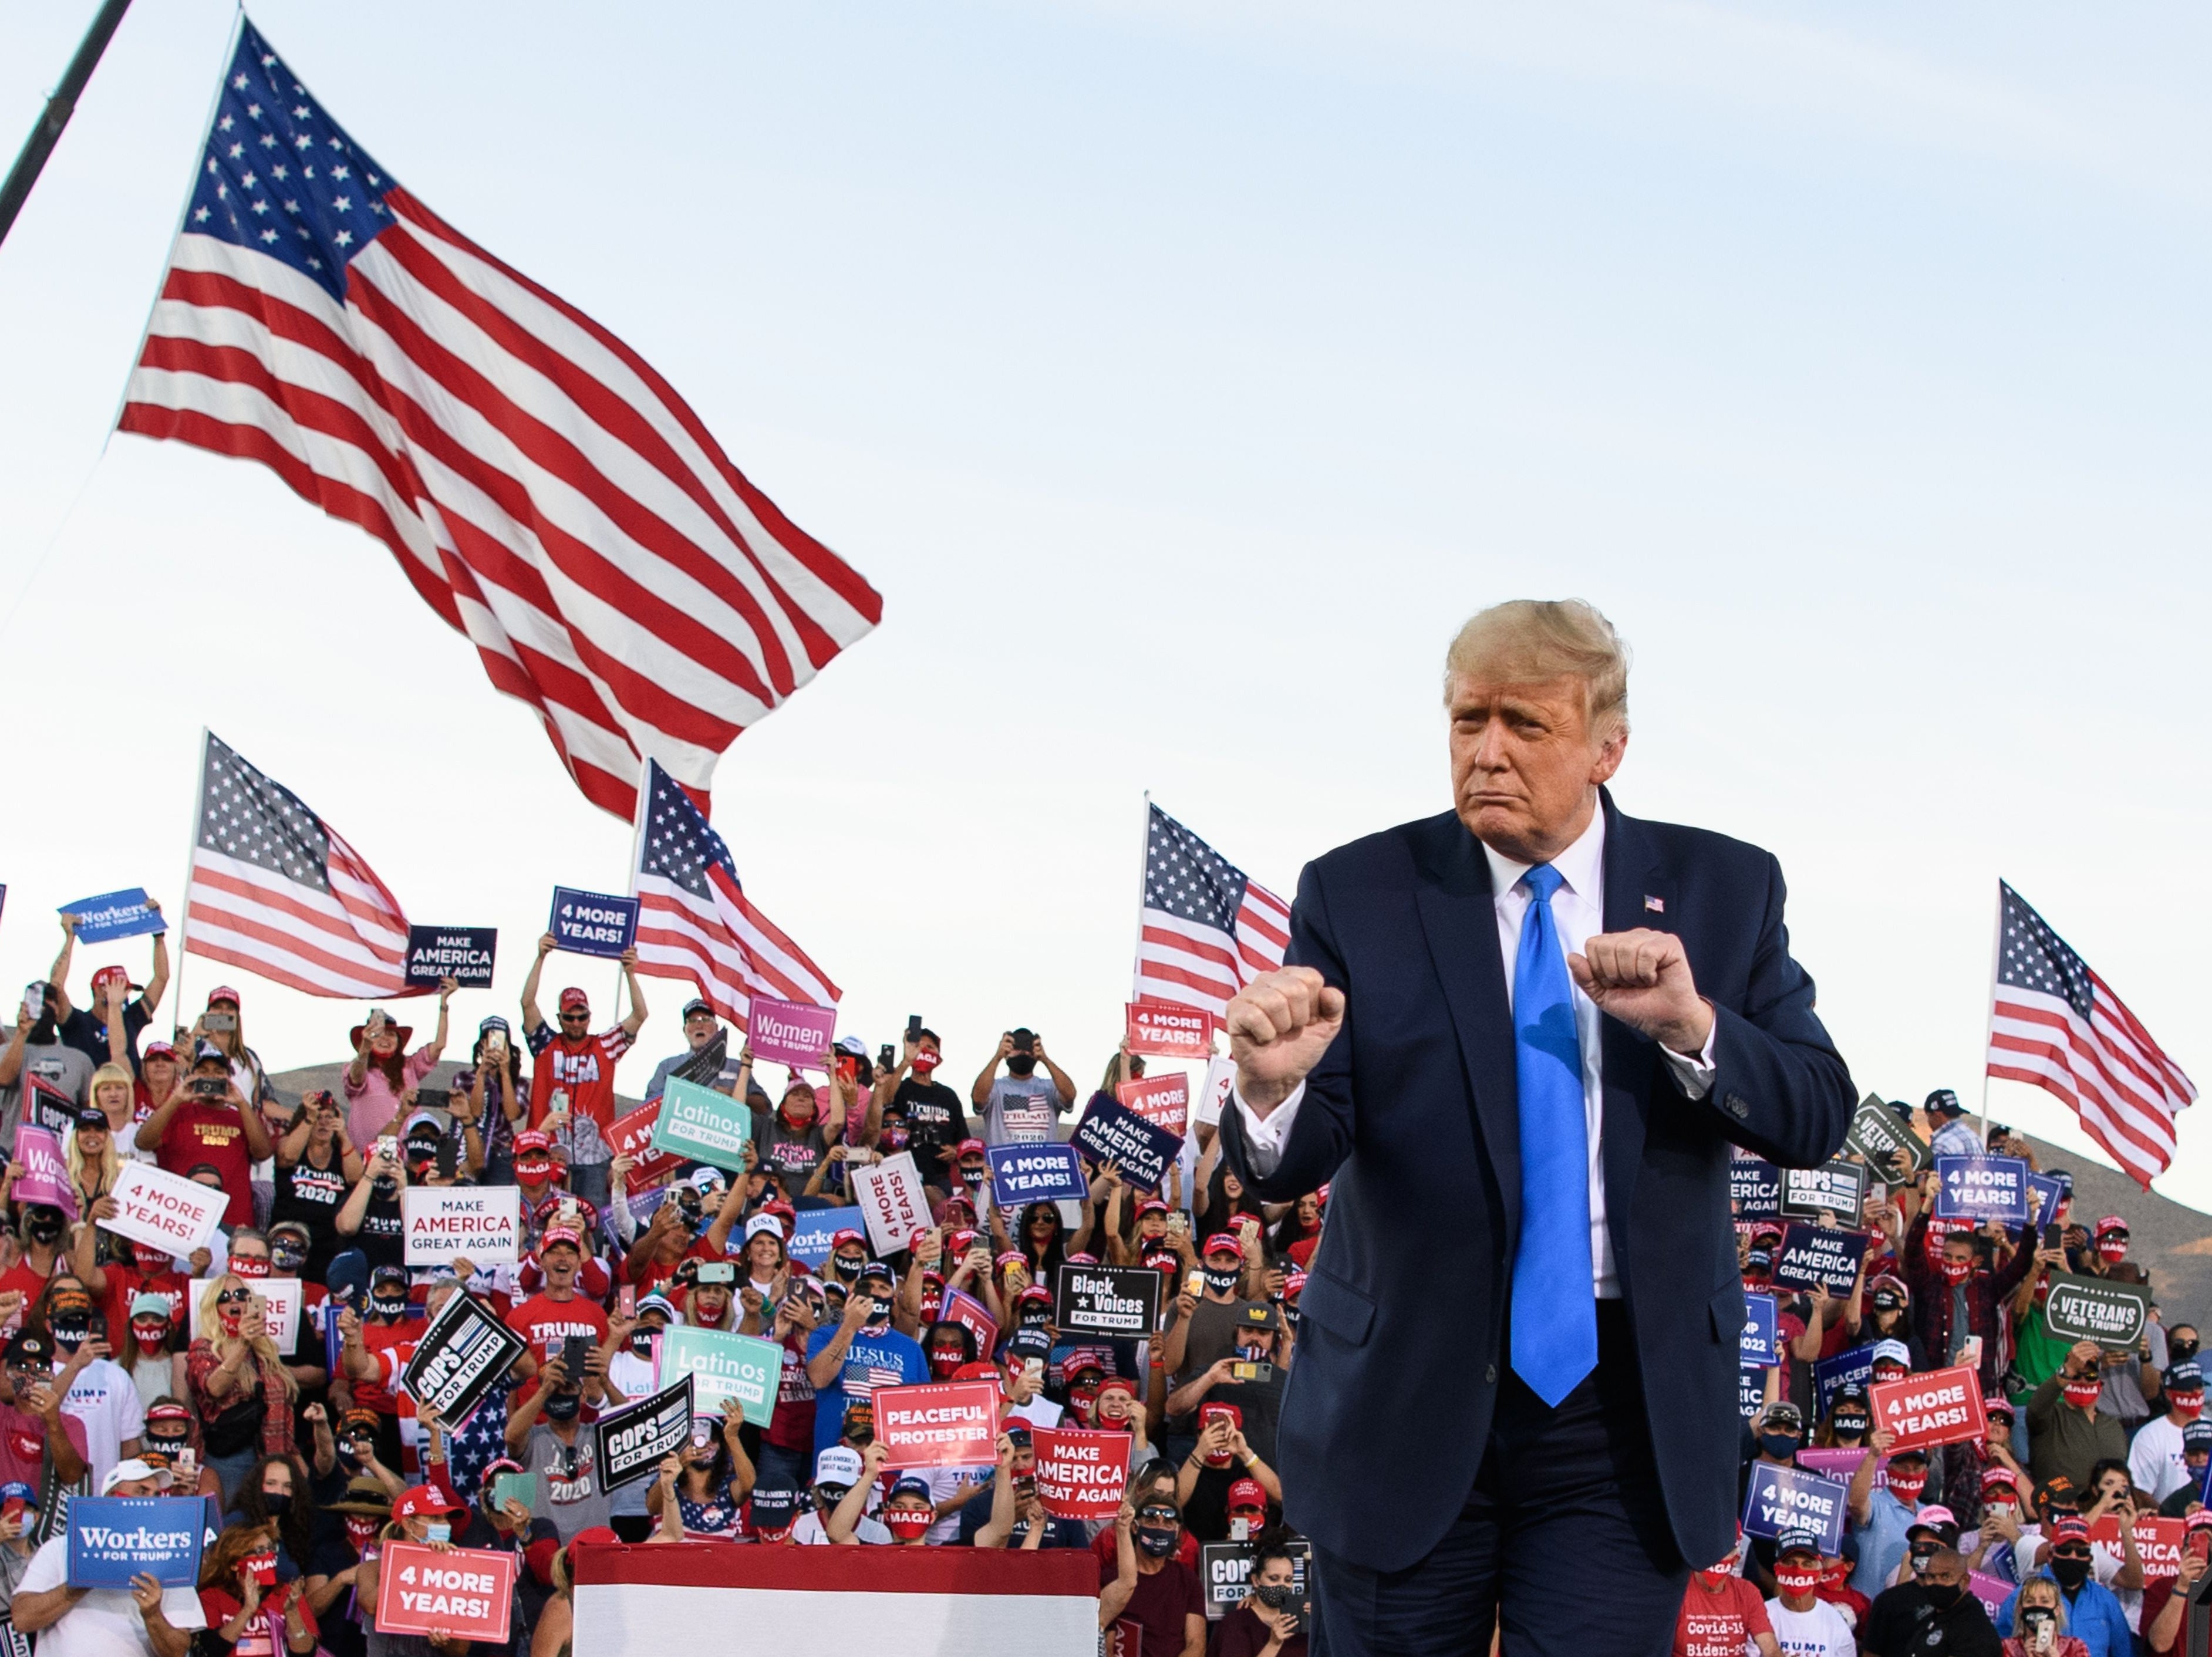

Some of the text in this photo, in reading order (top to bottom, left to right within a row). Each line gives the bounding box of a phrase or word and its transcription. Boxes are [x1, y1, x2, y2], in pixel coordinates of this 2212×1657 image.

[561, 905, 627, 926] 4 MORE
[437, 936, 471, 948] MAKE
[560, 922, 623, 943] YEARS!
[412, 949, 492, 965] AMERICA
[412, 966, 491, 978] GREAT AGAIN
[757, 1014, 823, 1045] Women
[1138, 1013, 1202, 1030] 4 MORE
[761, 1036, 815, 1052] FOR TRUMP
[1138, 1028, 1201, 1045] YEARS!
[916, 1052, 937, 1064] AGA
[907, 1100, 950, 1118] Trump
[1132, 1089, 1186, 1111] 4 MORE
[673, 1096, 741, 1136] Latinos
[194, 1124, 240, 1138] TRUMP
[672, 1123, 695, 1136] FOR
[699, 1130, 738, 1149] TRUMP
[1115, 1116, 1153, 1146] MAKE
[624, 1135, 636, 1150] 4
[1085, 1116, 1164, 1171] AMERICA
[1002, 1156, 1070, 1173] 4 MORE
[1079, 1129, 1158, 1184] GREAT AGAIN
[35, 1173, 57, 1184] FOR
[295, 1165, 345, 1186] Trump
[1004, 1173, 1072, 1191] YEARS!
[1788, 1169, 1832, 1190] COPS
[1947, 1170, 2018, 1187] 4 MORE
[295, 1184, 336, 1204] 2020
[871, 1173, 895, 1225] MORE
[1731, 1183, 1779, 1198] ERICA
[1949, 1188, 2017, 1205] YEARS!
[130, 1184, 205, 1223] 4 MORE
[441, 1200, 484, 1212] MAKE
[887, 1170, 918, 1232] YEARS!
[1790, 1192, 1855, 1210] FOR TRUMP
[124, 1201, 195, 1241] YEARS!
[413, 1216, 512, 1234] AMERICA
[753, 1217, 775, 1228] USA
[888, 1227, 900, 1238] 4
[412, 1237, 512, 1250] GREAT AGAIN
[1811, 1237, 1843, 1254] MAKE
[1783, 1247, 1857, 1273] AMERICA
[1071, 1274, 1115, 1295] Black
[1779, 1264, 1854, 1287] GREAT AGAIN
[266, 1300, 286, 1314] RE
[873, 1303, 889, 1314] GA
[1094, 1294, 1145, 1314] Voices
[2059, 1296, 2137, 1325] VETERANS
[1075, 1312, 1139, 1326] FOR TRUMP
[2066, 1315, 2126, 1332] FOR TRUMP
[530, 1322, 597, 1338] TRUMP
[679, 1346, 766, 1382] Latinos
[845, 1345, 904, 1366] JESUS
[417, 1346, 463, 1399] COPS
[436, 1337, 500, 1409] FOR TRUMP
[1823, 1365, 1873, 1391] PEACEF
[695, 1379, 761, 1398] OR TRUMP
[1887, 1386, 1966, 1415] 4 MORE
[887, 1406, 988, 1426] PEACEFUL
[1891, 1406, 1968, 1436] YEARS!
[608, 1418, 658, 1457] COPS
[614, 1423, 687, 1470] FOR TRUMP
[889, 1427, 988, 1446] PROTESTER
[1053, 1445, 1100, 1462] MAKE
[1037, 1459, 1124, 1484] AMERICA
[551, 1475, 592, 1501] 2020
[1038, 1482, 1122, 1503] GREAT AGAIN
[1762, 1484, 1833, 1516] 4 MORE
[890, 1512, 930, 1524] MAGA
[1762, 1504, 1828, 1537] YEARS!
[79, 1526, 192, 1550] Workers
[103, 1551, 172, 1561] FOR TRUMP
[1211, 1559, 1251, 1584] COP
[1707, 1563, 1732, 1574] AGA
[1820, 1572, 1840, 1582] GA
[399, 1565, 495, 1594] 4 MORE
[1777, 1574, 1815, 1587] MAGA
[1216, 1587, 1247, 1599] FOR
[399, 1591, 490, 1619] YEARS!
[1780, 1641, 1826, 1652] RUMP
